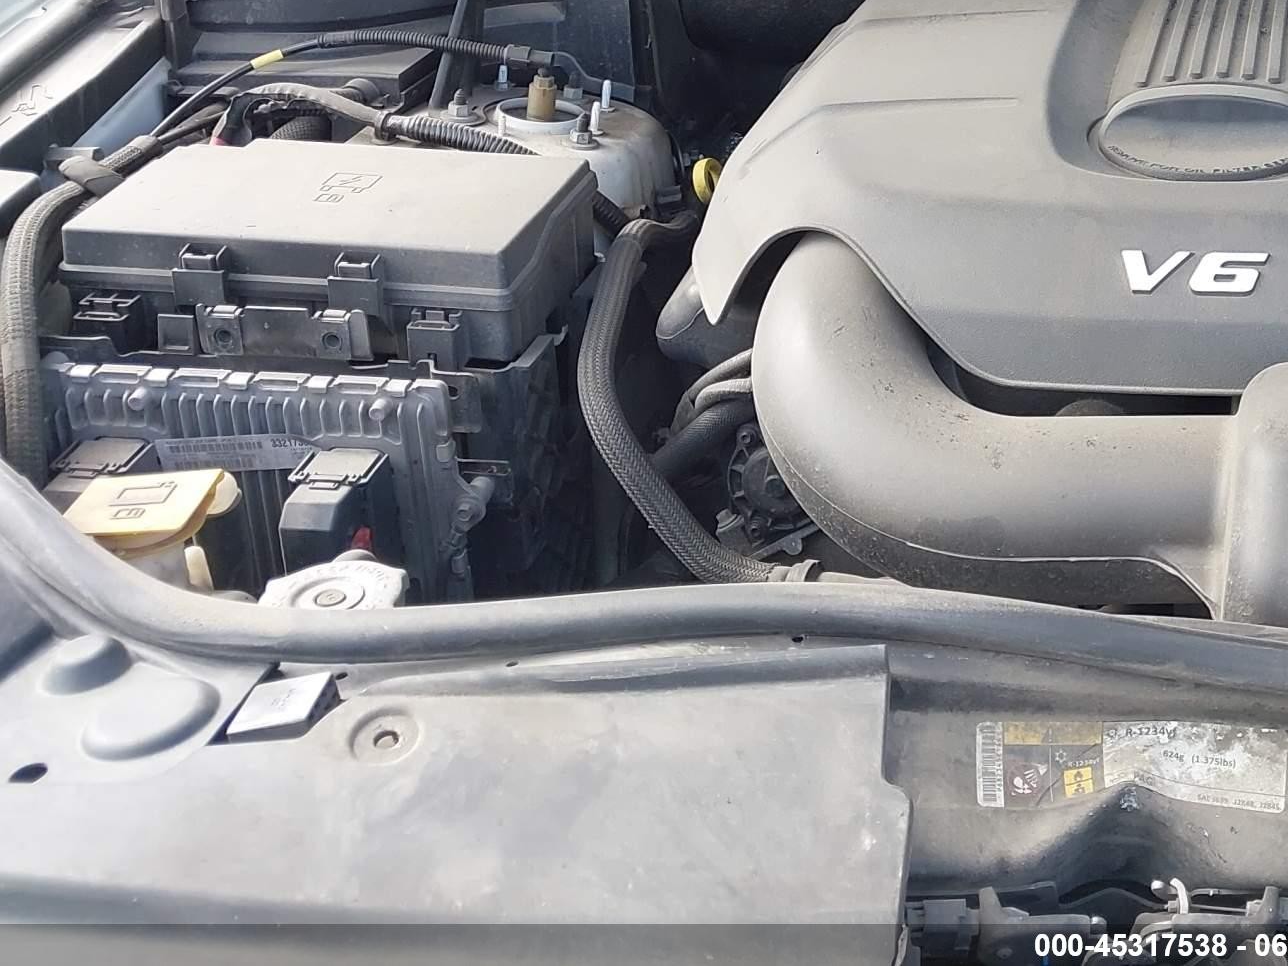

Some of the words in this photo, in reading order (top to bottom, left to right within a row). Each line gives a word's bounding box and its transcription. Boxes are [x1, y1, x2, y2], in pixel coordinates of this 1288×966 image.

[1121, 249, 1271, 296] V6
[1125, 725, 1177, 739] R-1234yf
[1162, 749, 1185, 763] 624g
[1191, 754, 1237, 769] (1.375lbs)
